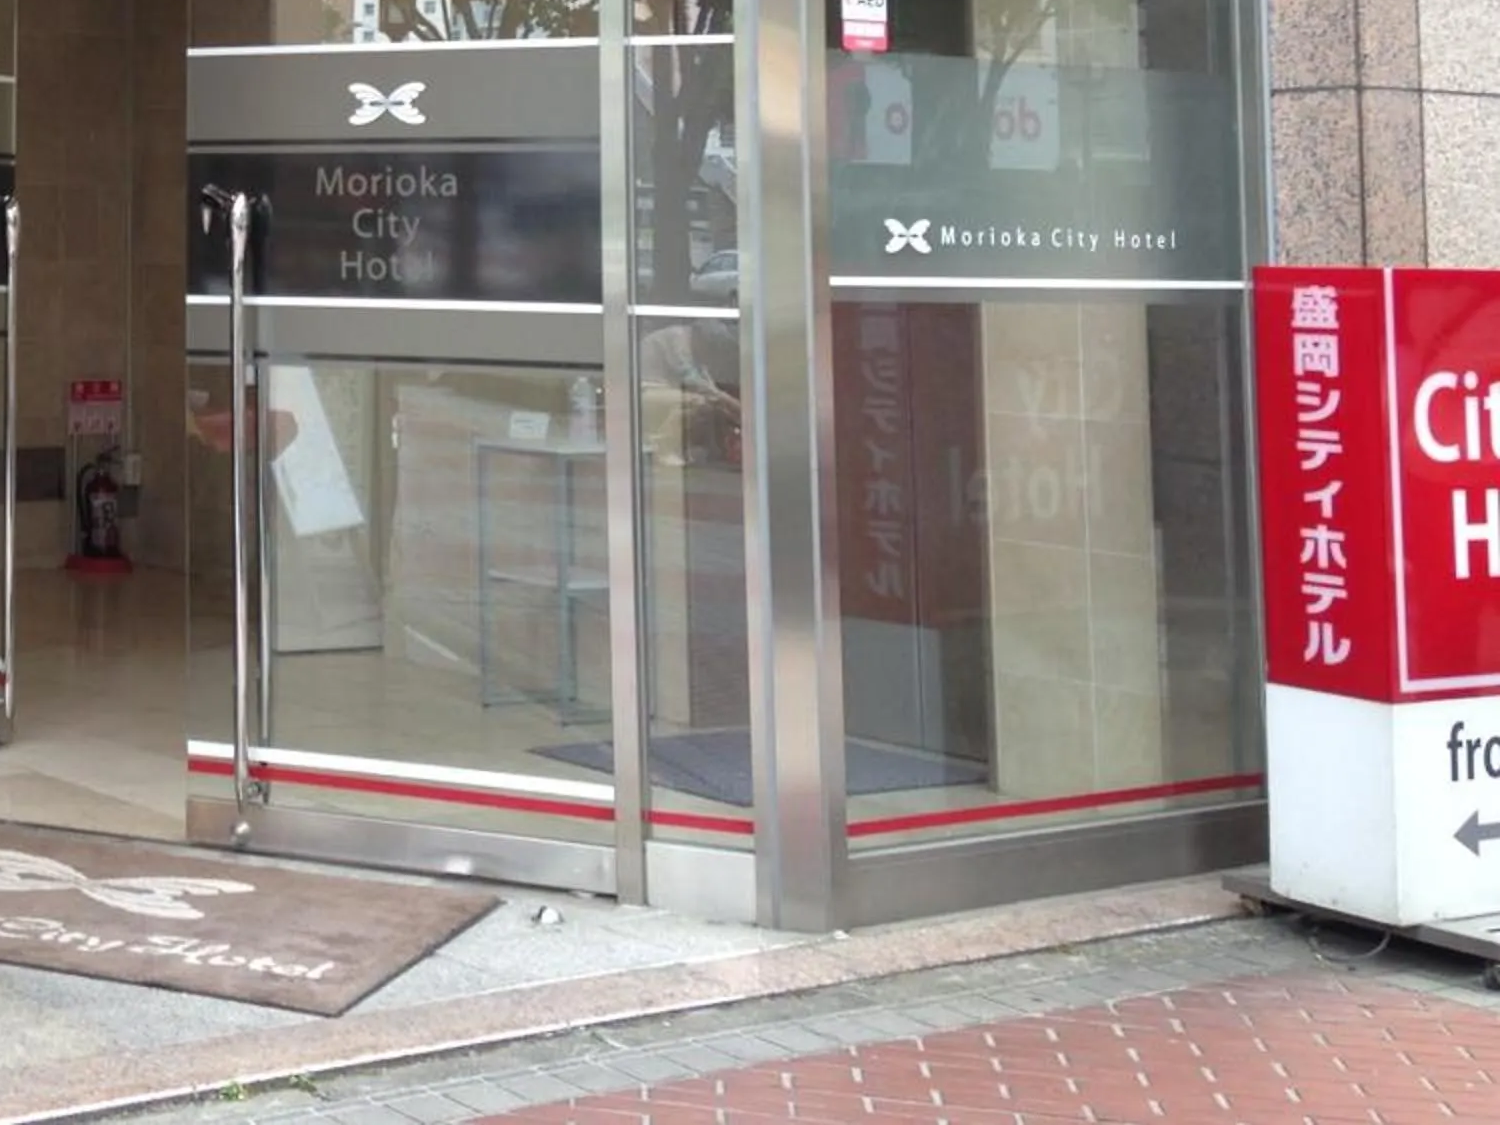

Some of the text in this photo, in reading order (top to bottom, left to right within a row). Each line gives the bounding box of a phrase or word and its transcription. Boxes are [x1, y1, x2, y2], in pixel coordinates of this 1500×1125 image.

[315, 165, 457, 197] Morioka
[352, 208, 421, 246] City
[940, 226, 1177, 252] Morioka City Hotel
[1289, 285, 1351, 666] 盛岡シティホテル
